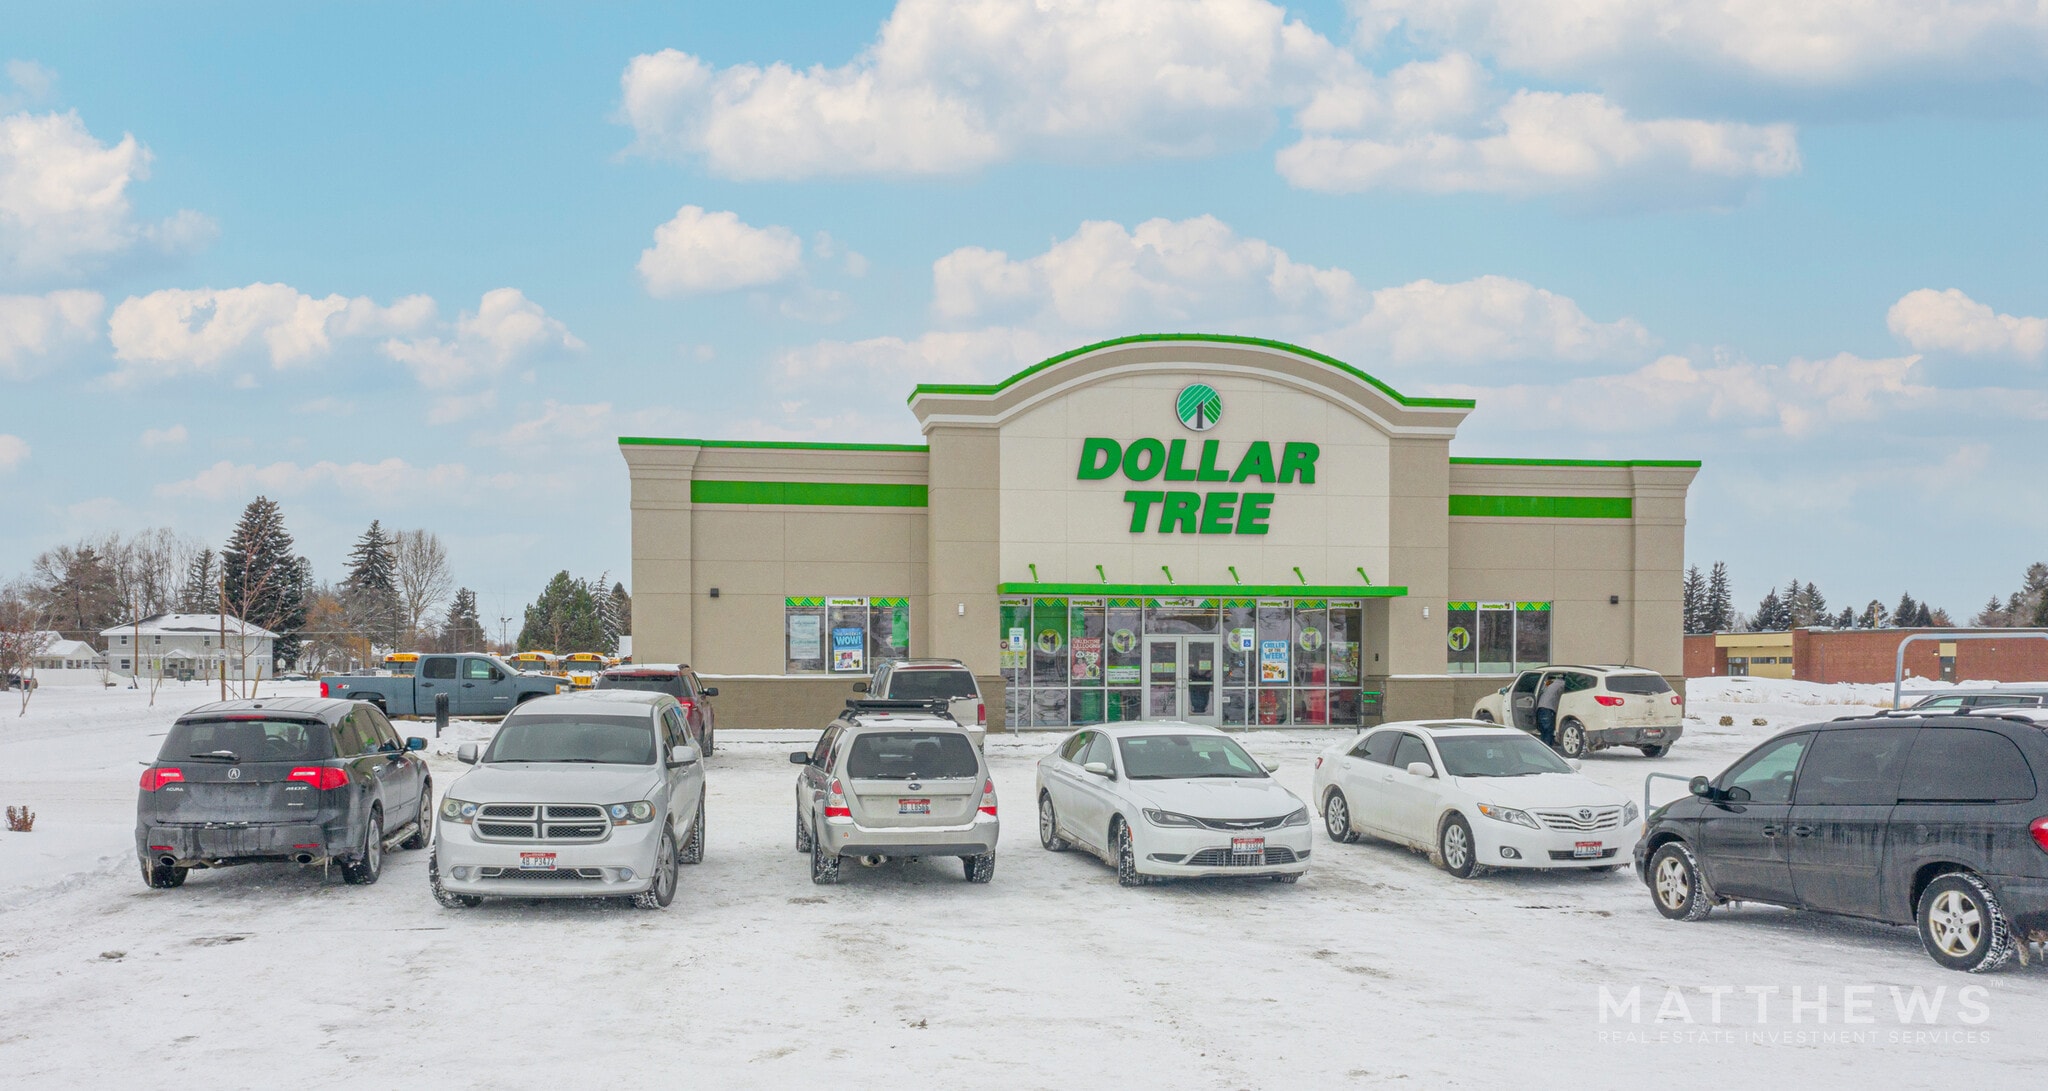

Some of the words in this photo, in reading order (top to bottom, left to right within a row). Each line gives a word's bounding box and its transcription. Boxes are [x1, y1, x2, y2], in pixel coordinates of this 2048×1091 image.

[1077, 437, 1320, 484] DOLLAR
[1123, 490, 1275, 534] TREE
[835, 635, 862, 646] WOW!
[1453, 632, 1464, 650] $1
